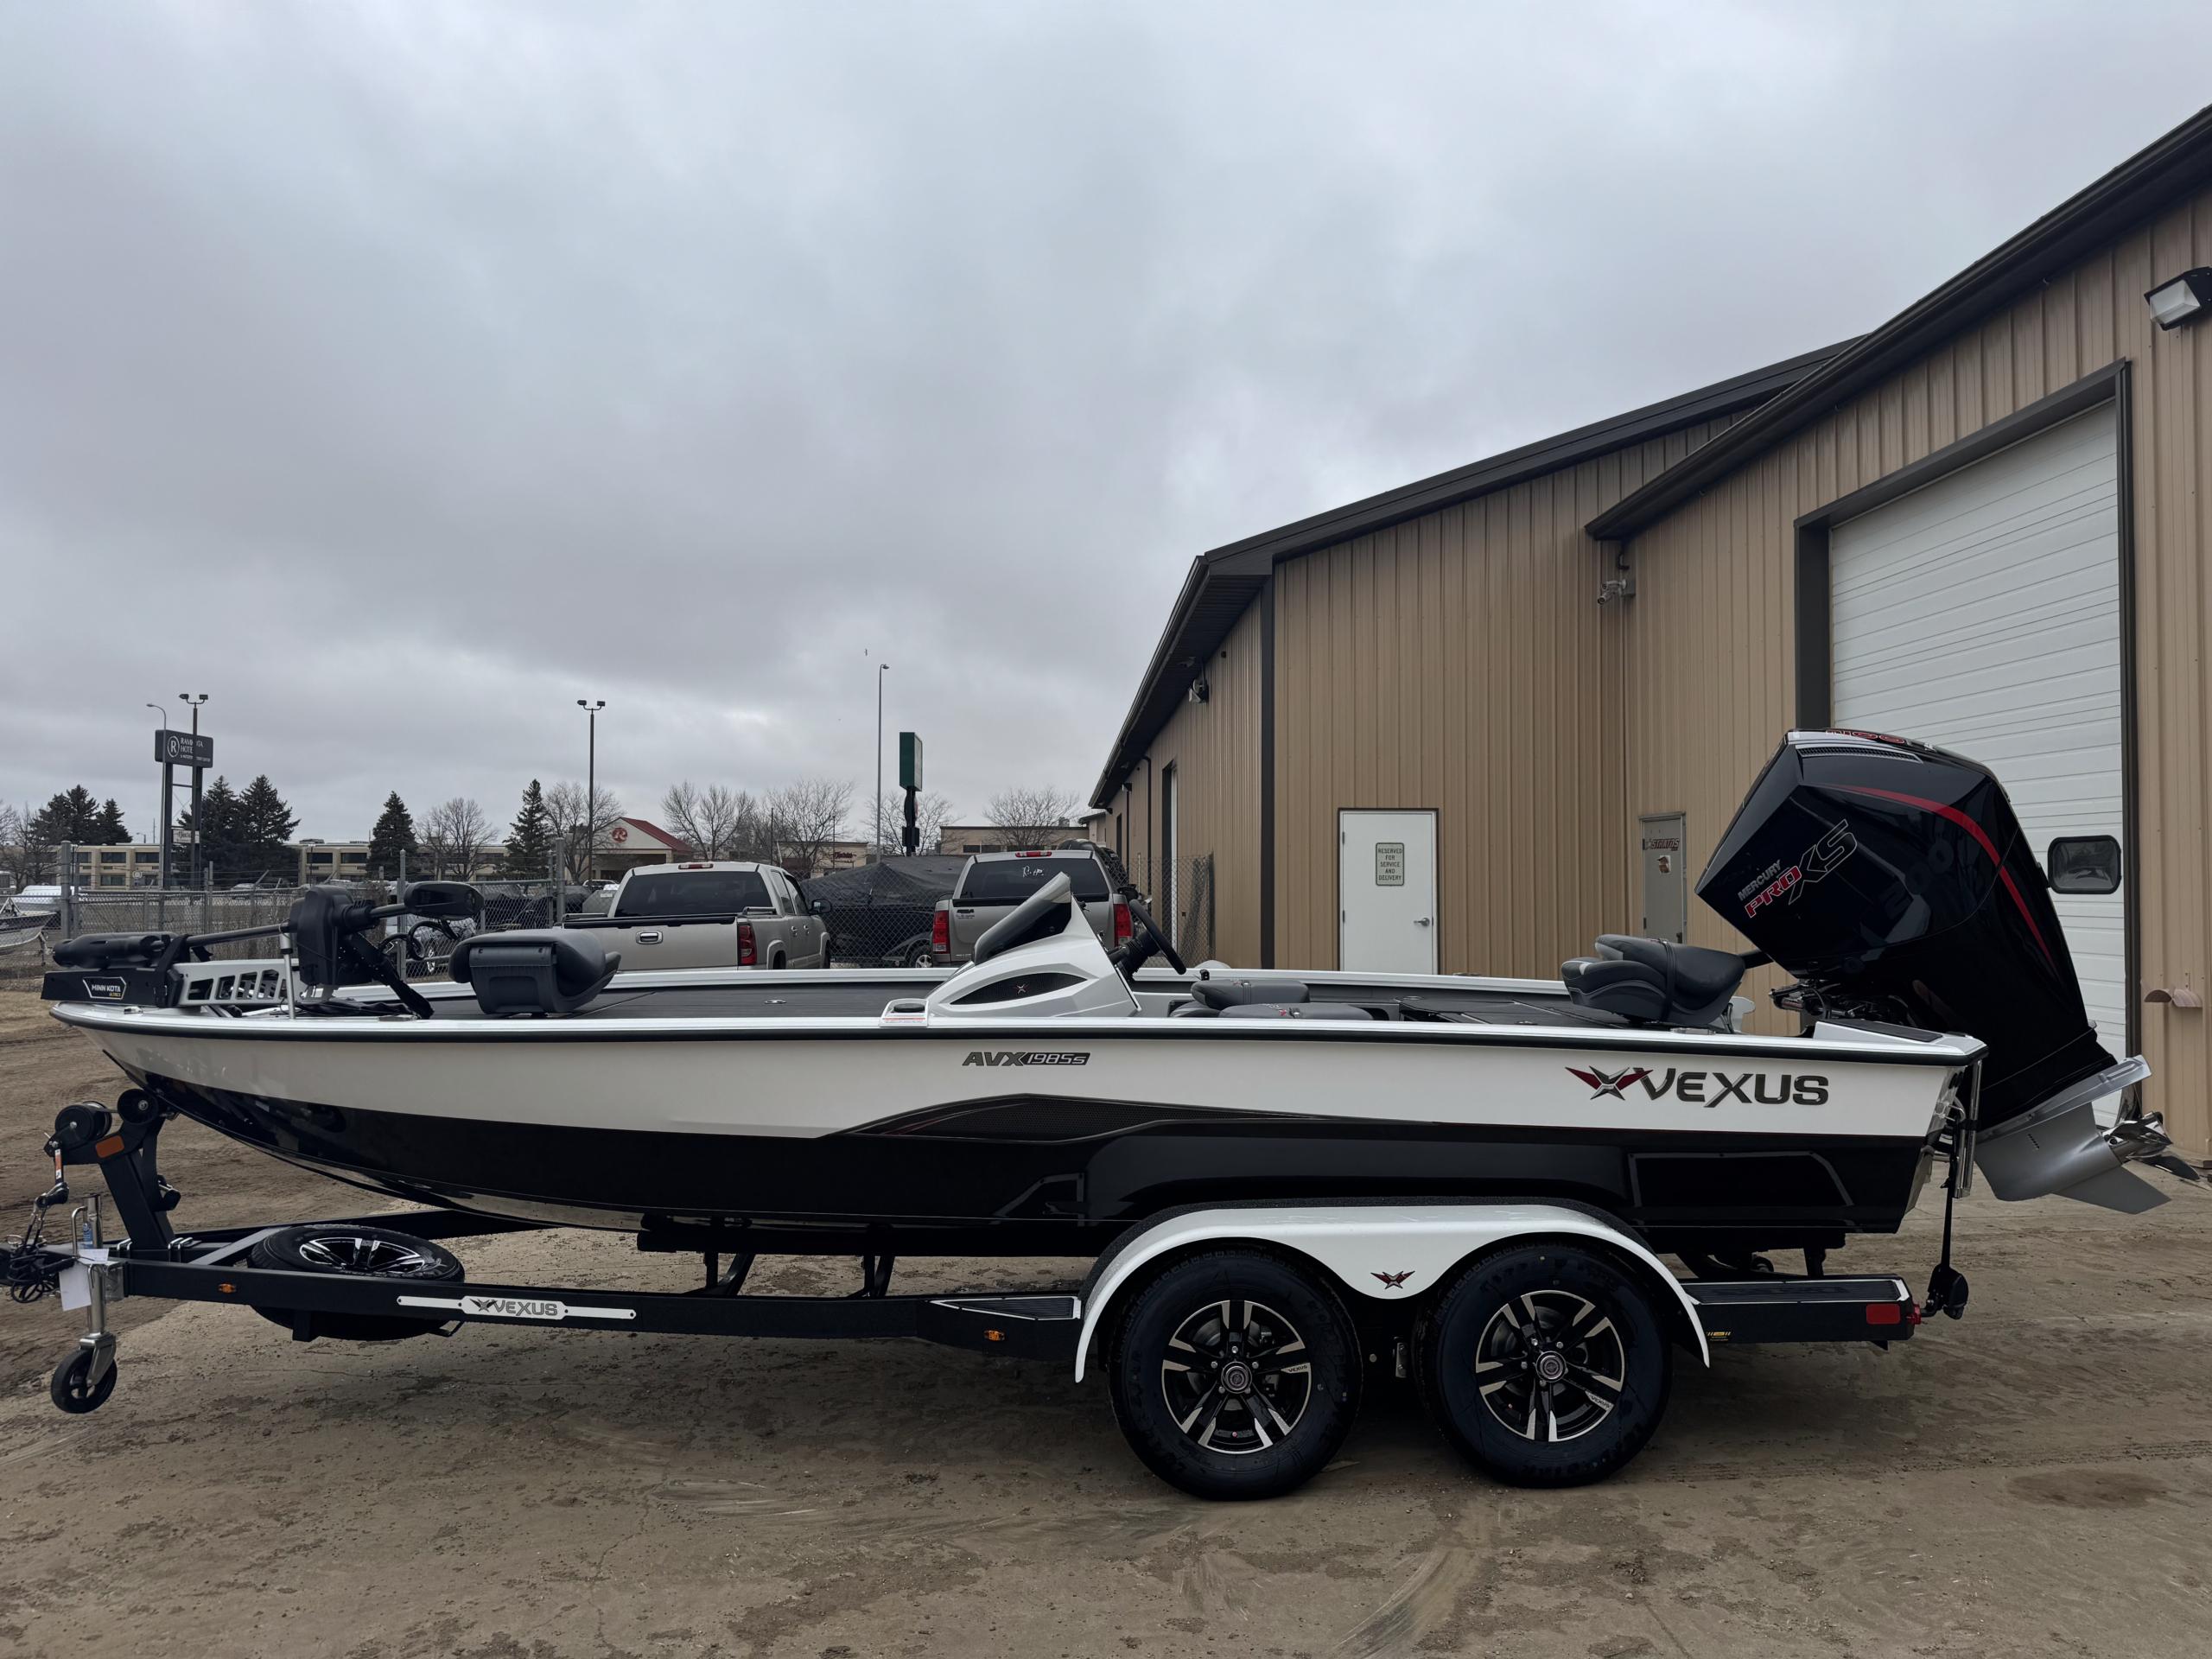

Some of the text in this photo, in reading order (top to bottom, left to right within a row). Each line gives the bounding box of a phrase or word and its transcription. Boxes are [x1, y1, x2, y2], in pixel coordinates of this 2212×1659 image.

[180, 745, 194, 753] HOTE
[1651, 838, 1680, 849] STRATOS
[1738, 859, 1781, 901] MERCURY
[1745, 865, 1802, 918] PRO
[1632, 1067, 1829, 1109] VEXUS
[491, 1299, 558, 1316] VEXUS
[1287, 1364, 1307, 1373] VEXUS
[1591, 1395, 1610, 1408] VEXUS
